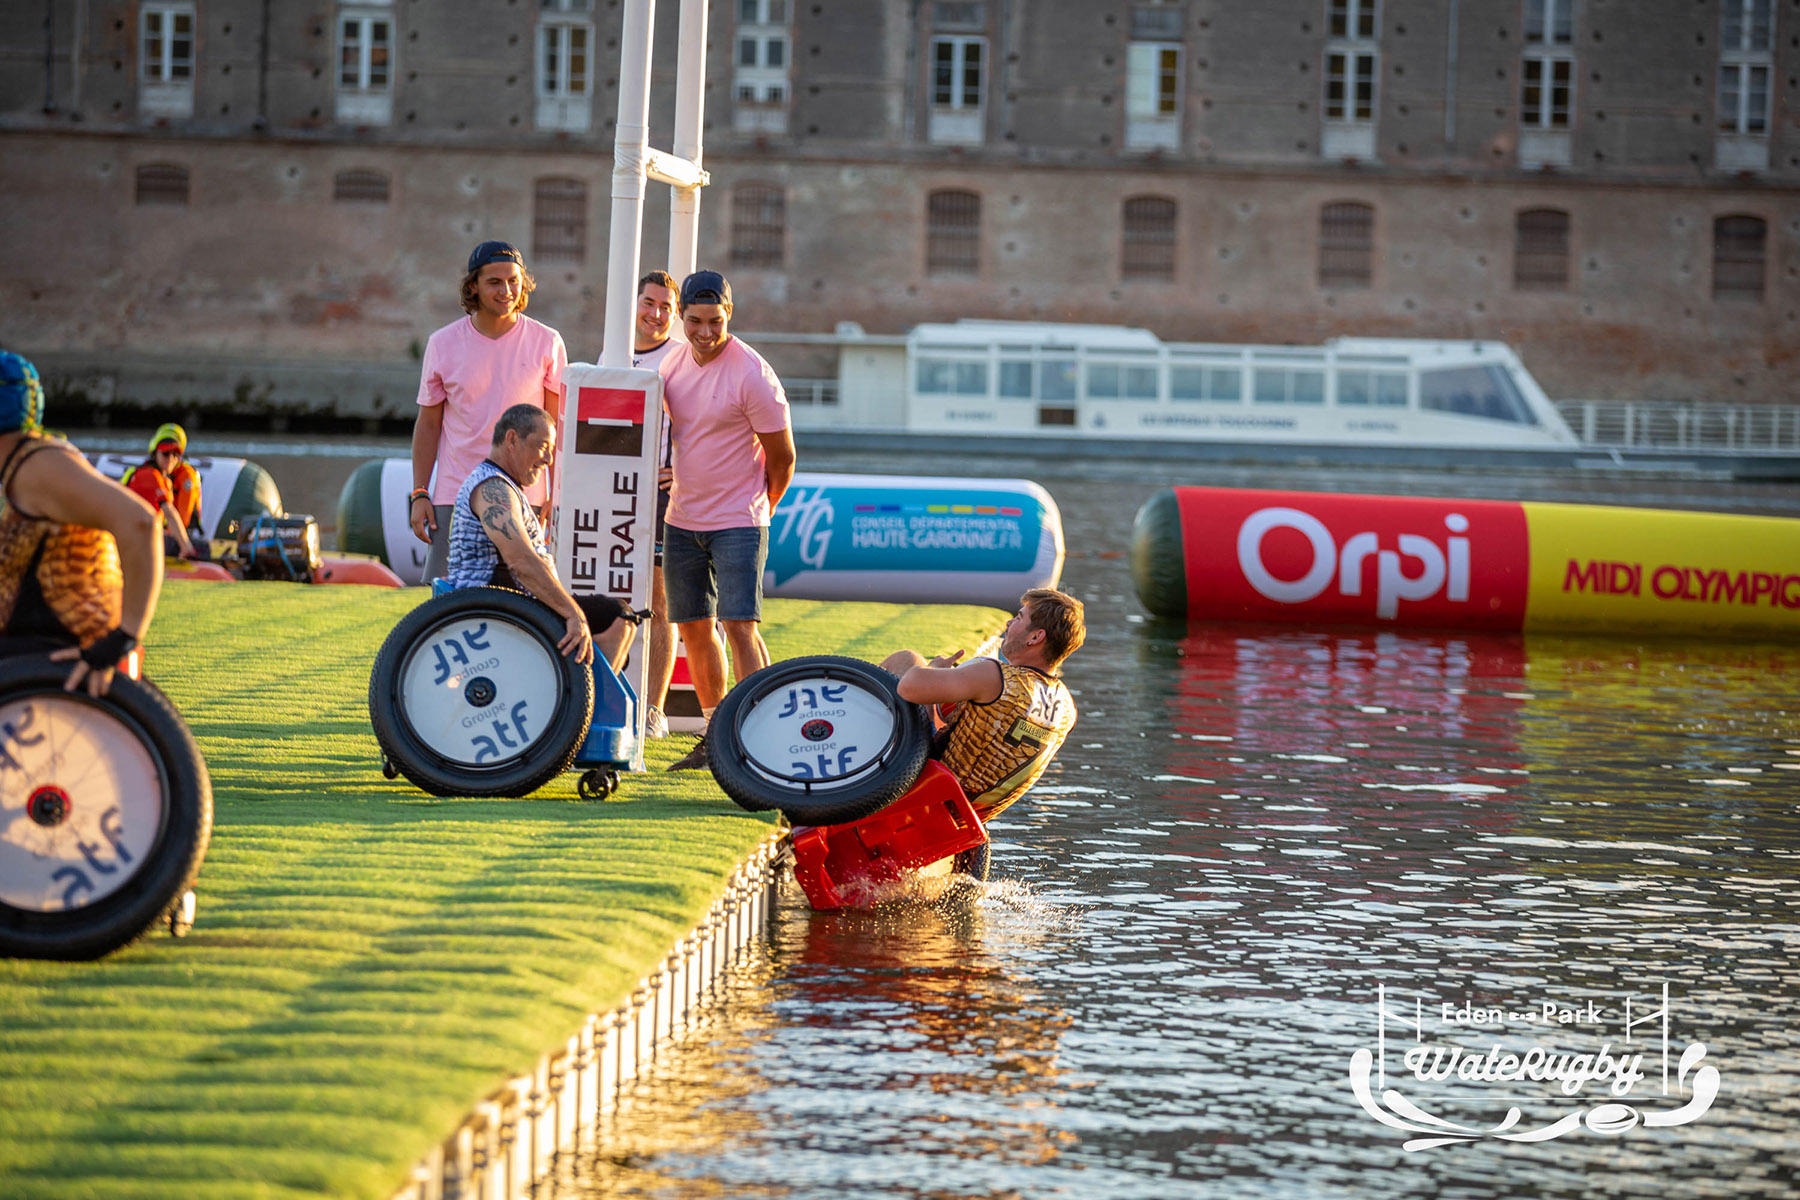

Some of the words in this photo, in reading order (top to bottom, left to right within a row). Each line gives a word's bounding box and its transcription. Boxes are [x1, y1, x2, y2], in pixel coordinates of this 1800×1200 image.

[608, 472, 638, 604] ERALE
[851, 516, 905, 530] CONSEIL
[571, 508, 599, 595] IETE
[1236, 506, 1471, 620] Orpi
[1562, 558, 1642, 597] MIDI
[460, 701, 507, 729] Groupe
[470, 699, 530, 764] atf
[798, 708, 847, 720] Groupe
[787, 745, 858, 785] atf
[788, 741, 837, 754] Groupe
